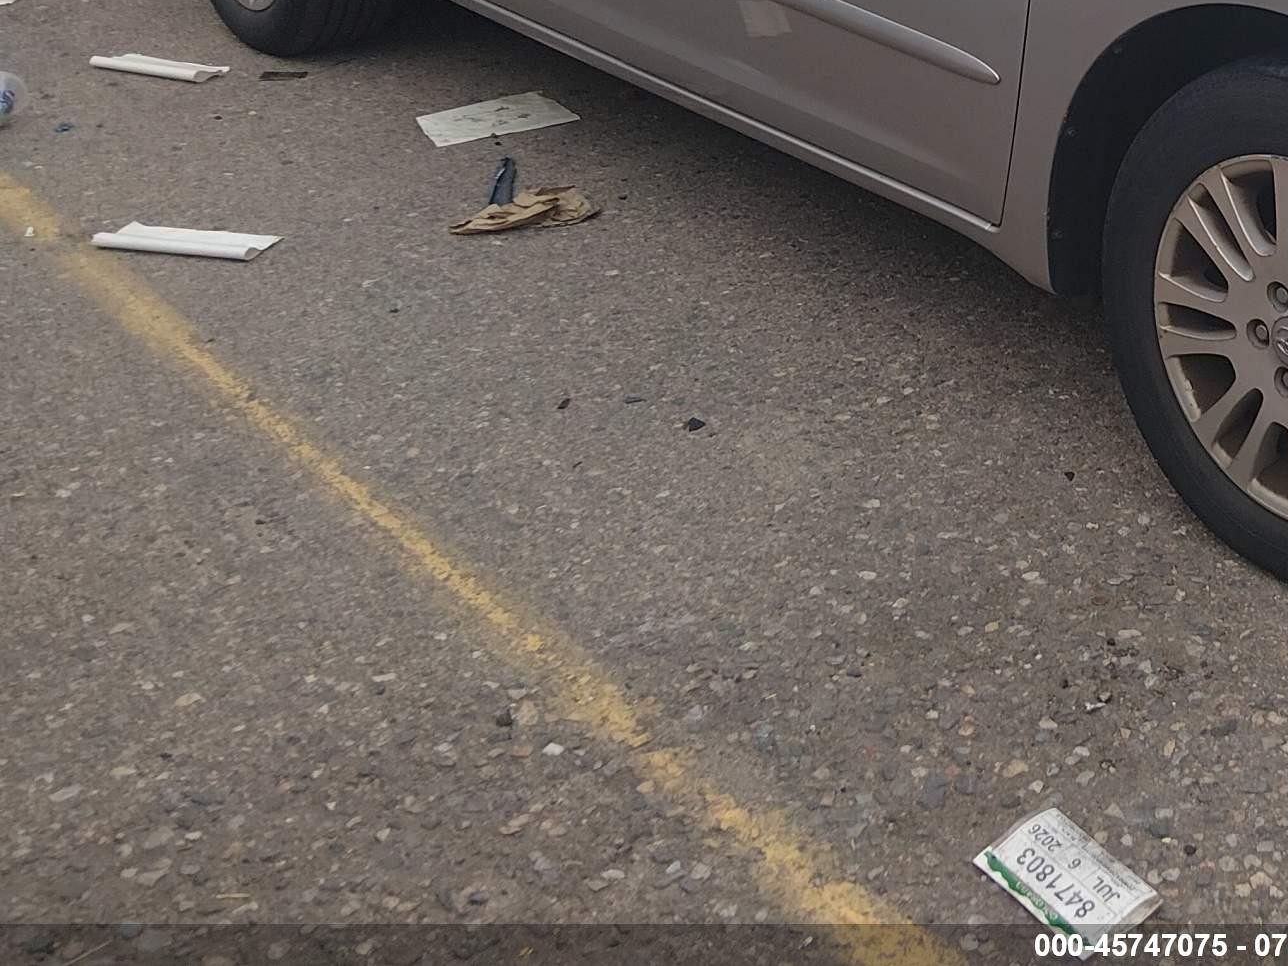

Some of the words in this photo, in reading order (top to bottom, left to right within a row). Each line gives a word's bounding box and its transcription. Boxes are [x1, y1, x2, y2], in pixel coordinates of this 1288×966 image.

[1027, 823, 1062, 852] 2026
[1067, 857, 1082, 870] 6
[1016, 847, 1096, 919] 8471803
[1092, 876, 1121, 903] JUL
